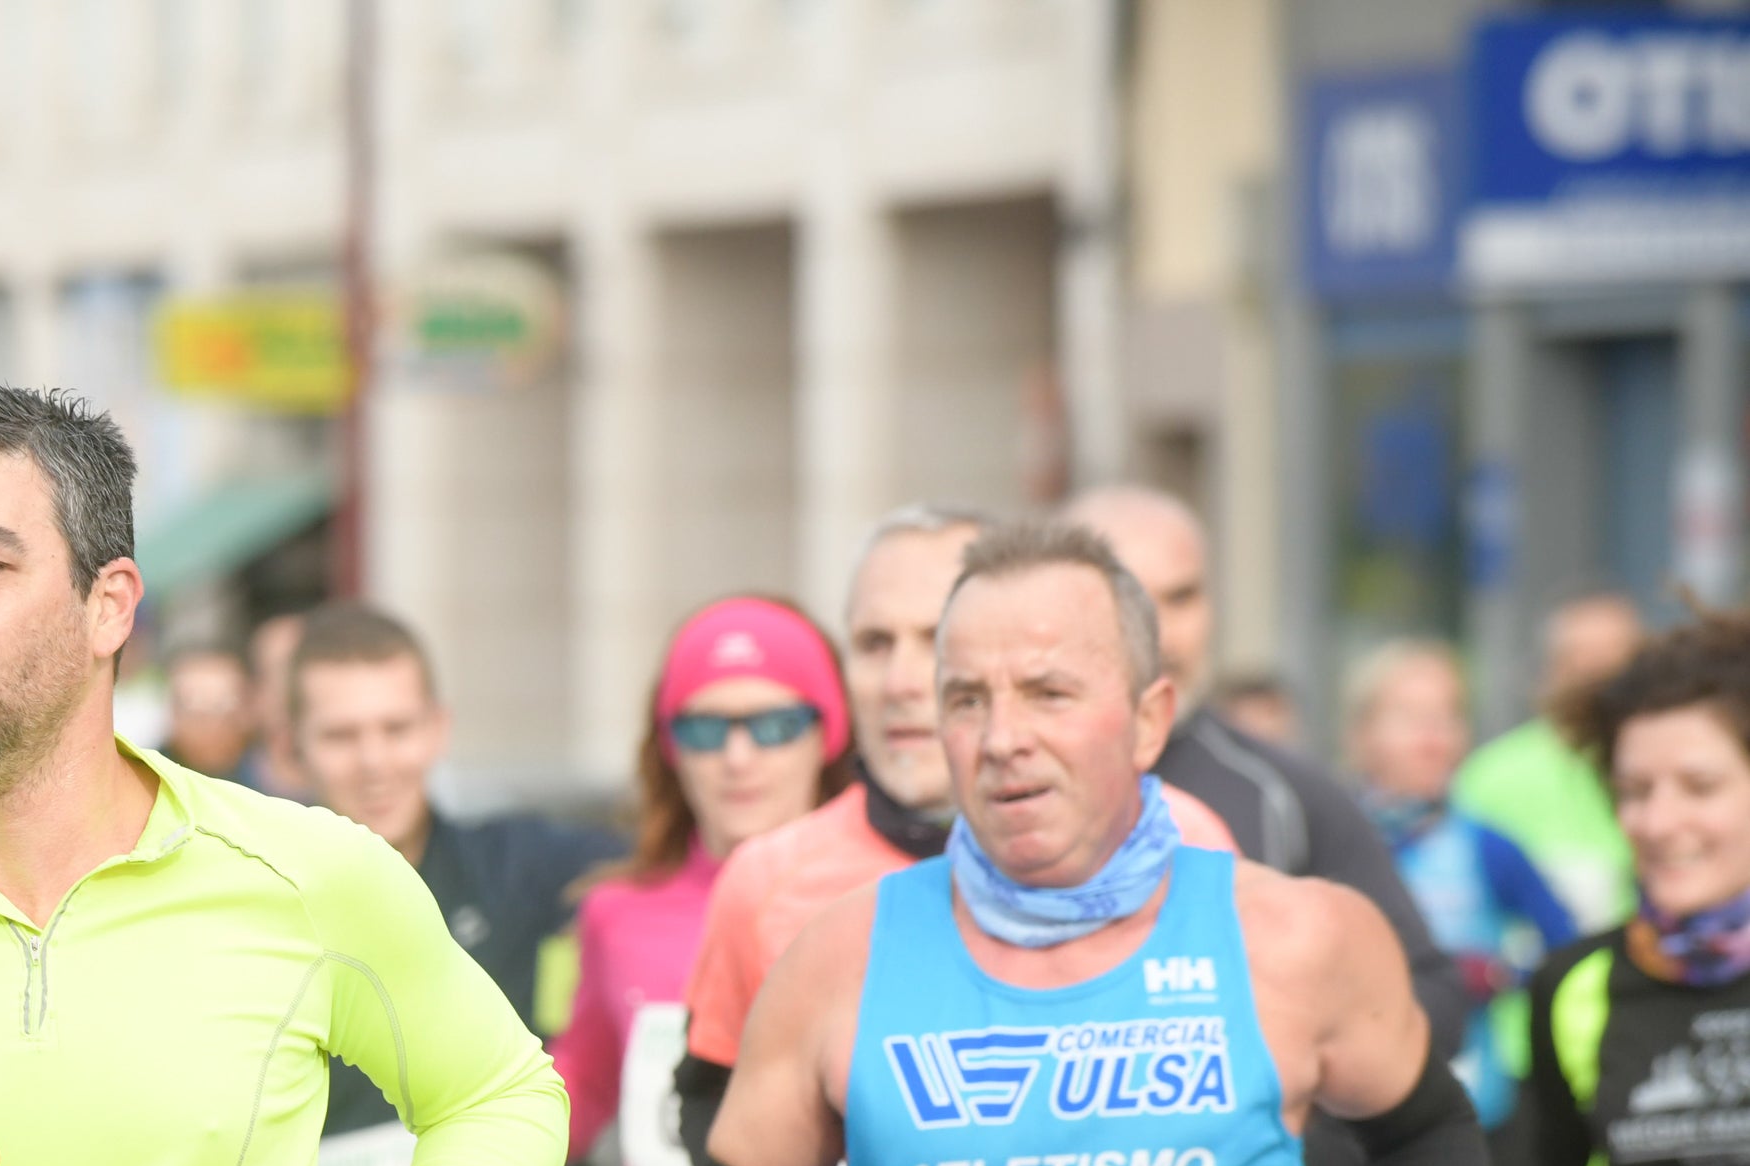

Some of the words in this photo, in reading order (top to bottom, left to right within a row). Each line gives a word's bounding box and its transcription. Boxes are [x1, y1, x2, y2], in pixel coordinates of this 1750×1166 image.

[1143, 956, 1217, 992] HH
[1055, 1021, 1223, 1053] COMERCIAL
[1054, 1053, 1230, 1114] ULSA
